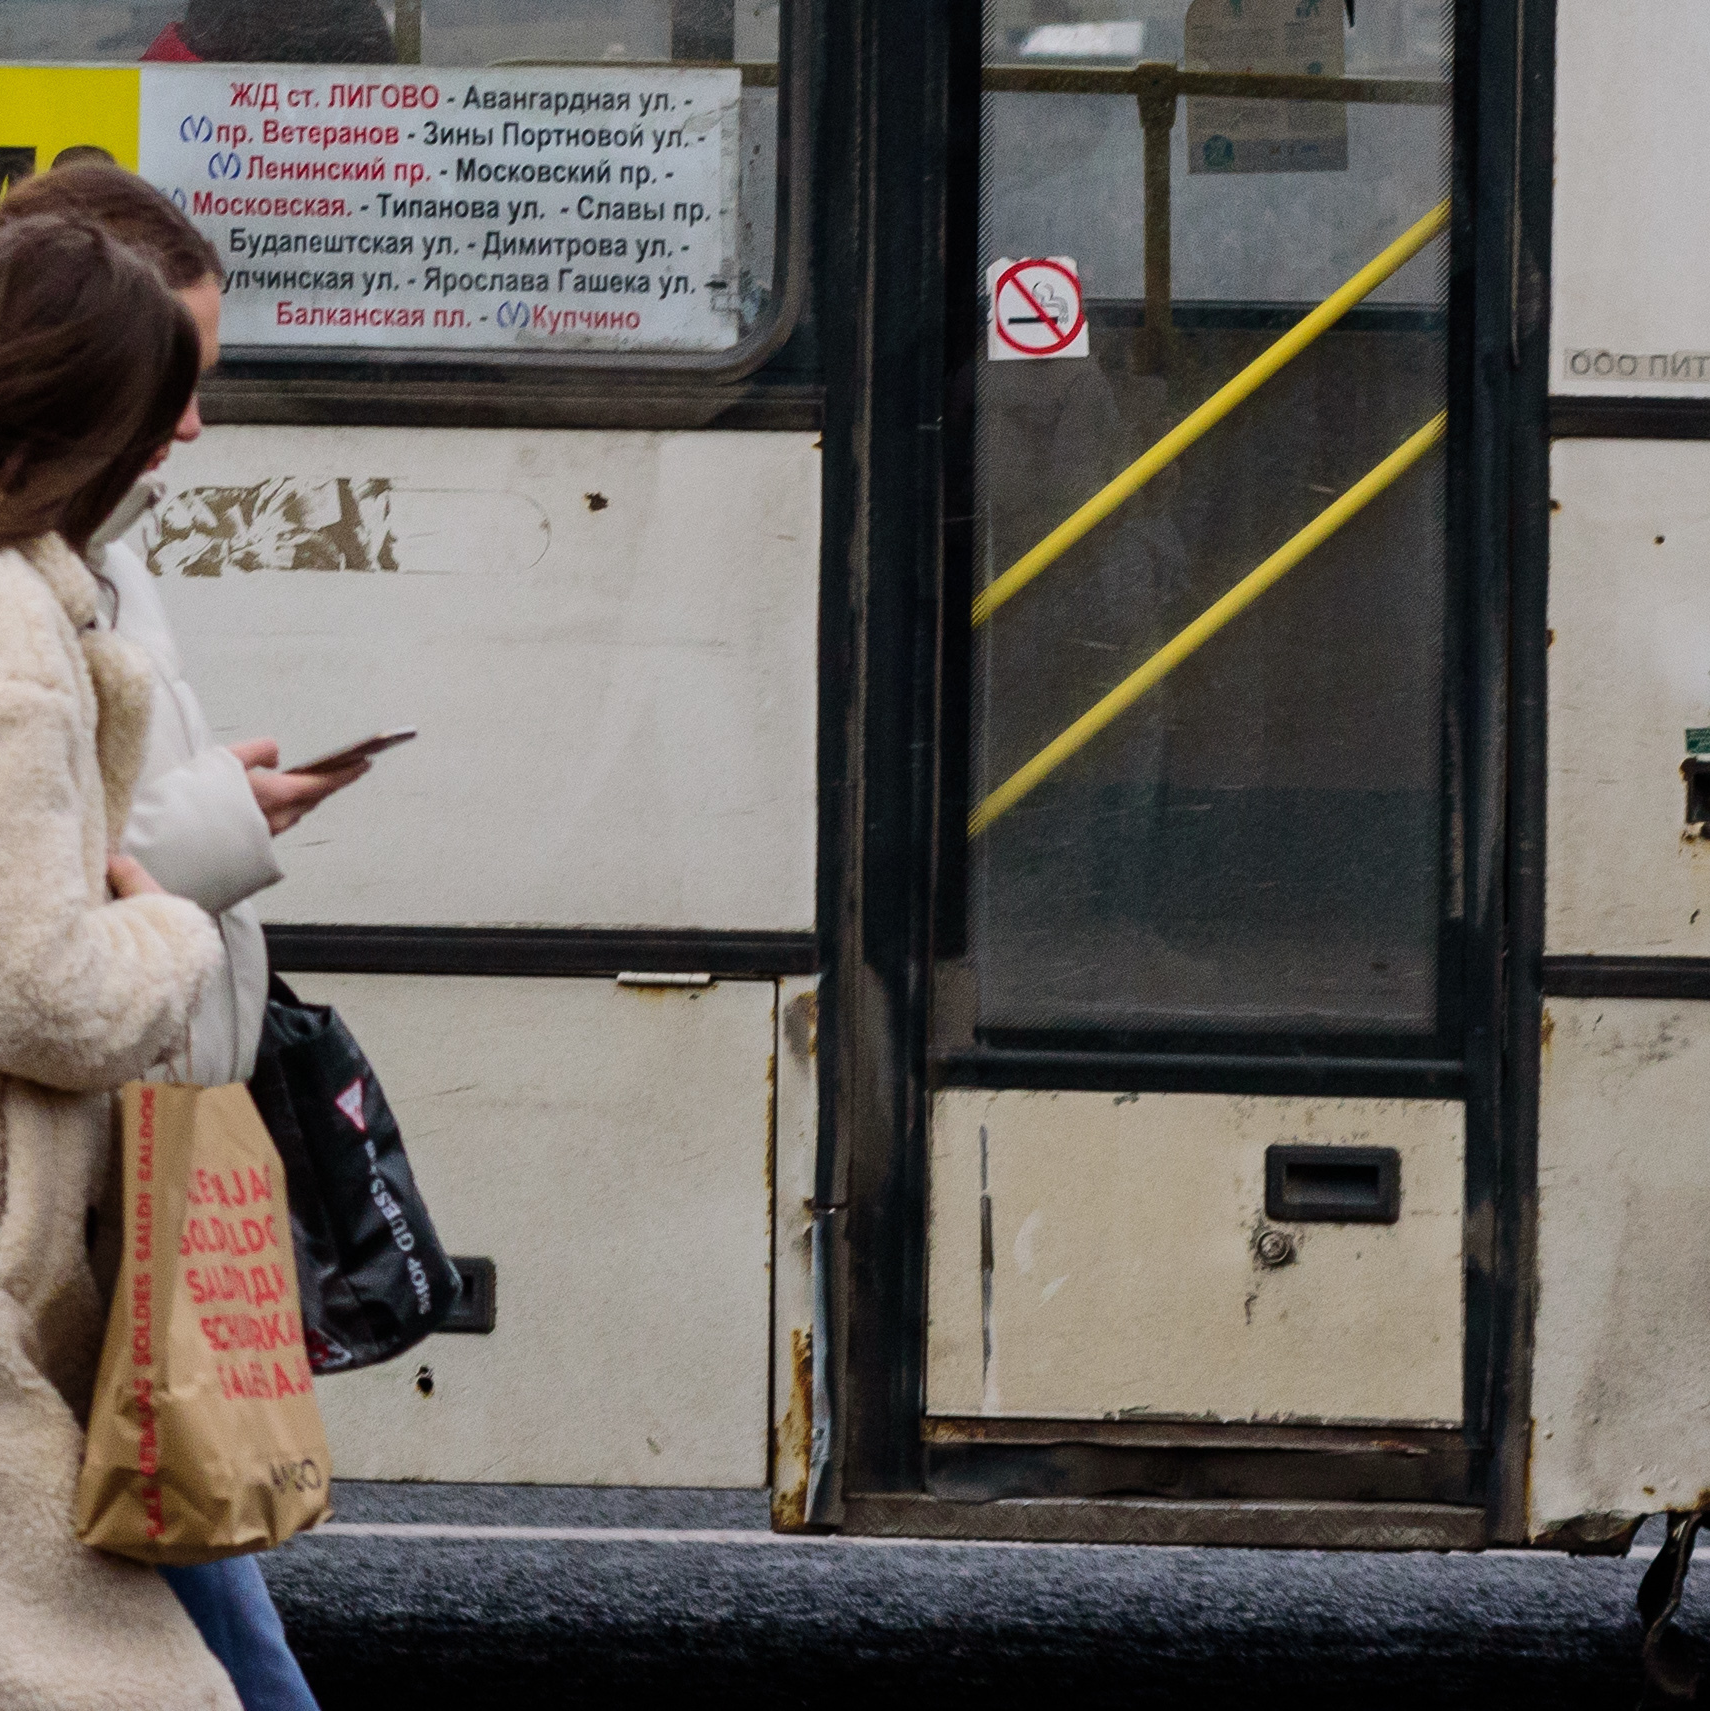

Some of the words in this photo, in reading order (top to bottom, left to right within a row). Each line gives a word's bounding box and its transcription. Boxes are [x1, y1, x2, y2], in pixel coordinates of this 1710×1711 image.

[231, 83, 278, 110] Ж/Д
[288, 90, 318, 107] ст.
[329, 85, 439, 108] ЛИГОВО
[463, 85, 630, 115] Авангардная
[640, 93, 675, 117] ул.
[217, 125, 252, 148] пр.
[264, 120, 399, 149] Ветеранов
[424, 121, 493, 145] Зины
[503, 122, 643, 152] Портновой
[653, 129, 688, 153] ул.
[247, 156, 384, 180] Ленинский
[394, 164, 430, 187] пр.
[457, 158, 610, 183] Московский
[620, 166, 656, 190] пр.
[194, 192, 351, 216] Московская.
[377, 193, 499, 219] Типанова
[508, 201, 544, 225] ул.
[577, 195, 664, 220] Славы
[674, 203, 710, 226] пр.
[230, 228, 413, 259] Будапештская
[423, 237, 458, 261] ул.
[482, 231, 627, 261] Димитрова
[636, 239, 672, 263] ул.
[222, 269, 353, 294] упчинская
[362, 272, 399, 296] ул.
[424, 267, 549, 296] Ярослава
[559, 268, 650, 293] Гашека
[659, 276, 695, 299] ул.
[277, 301, 424, 326] Балканская
[434, 310, 470, 327] пл.
[533, 305, 640, 336] Купчино
[1570, 350, 1638, 376] ООО
[135, 1193, 152, 1262] SALDI
[133, 1273, 152, 1366] SOLDES
